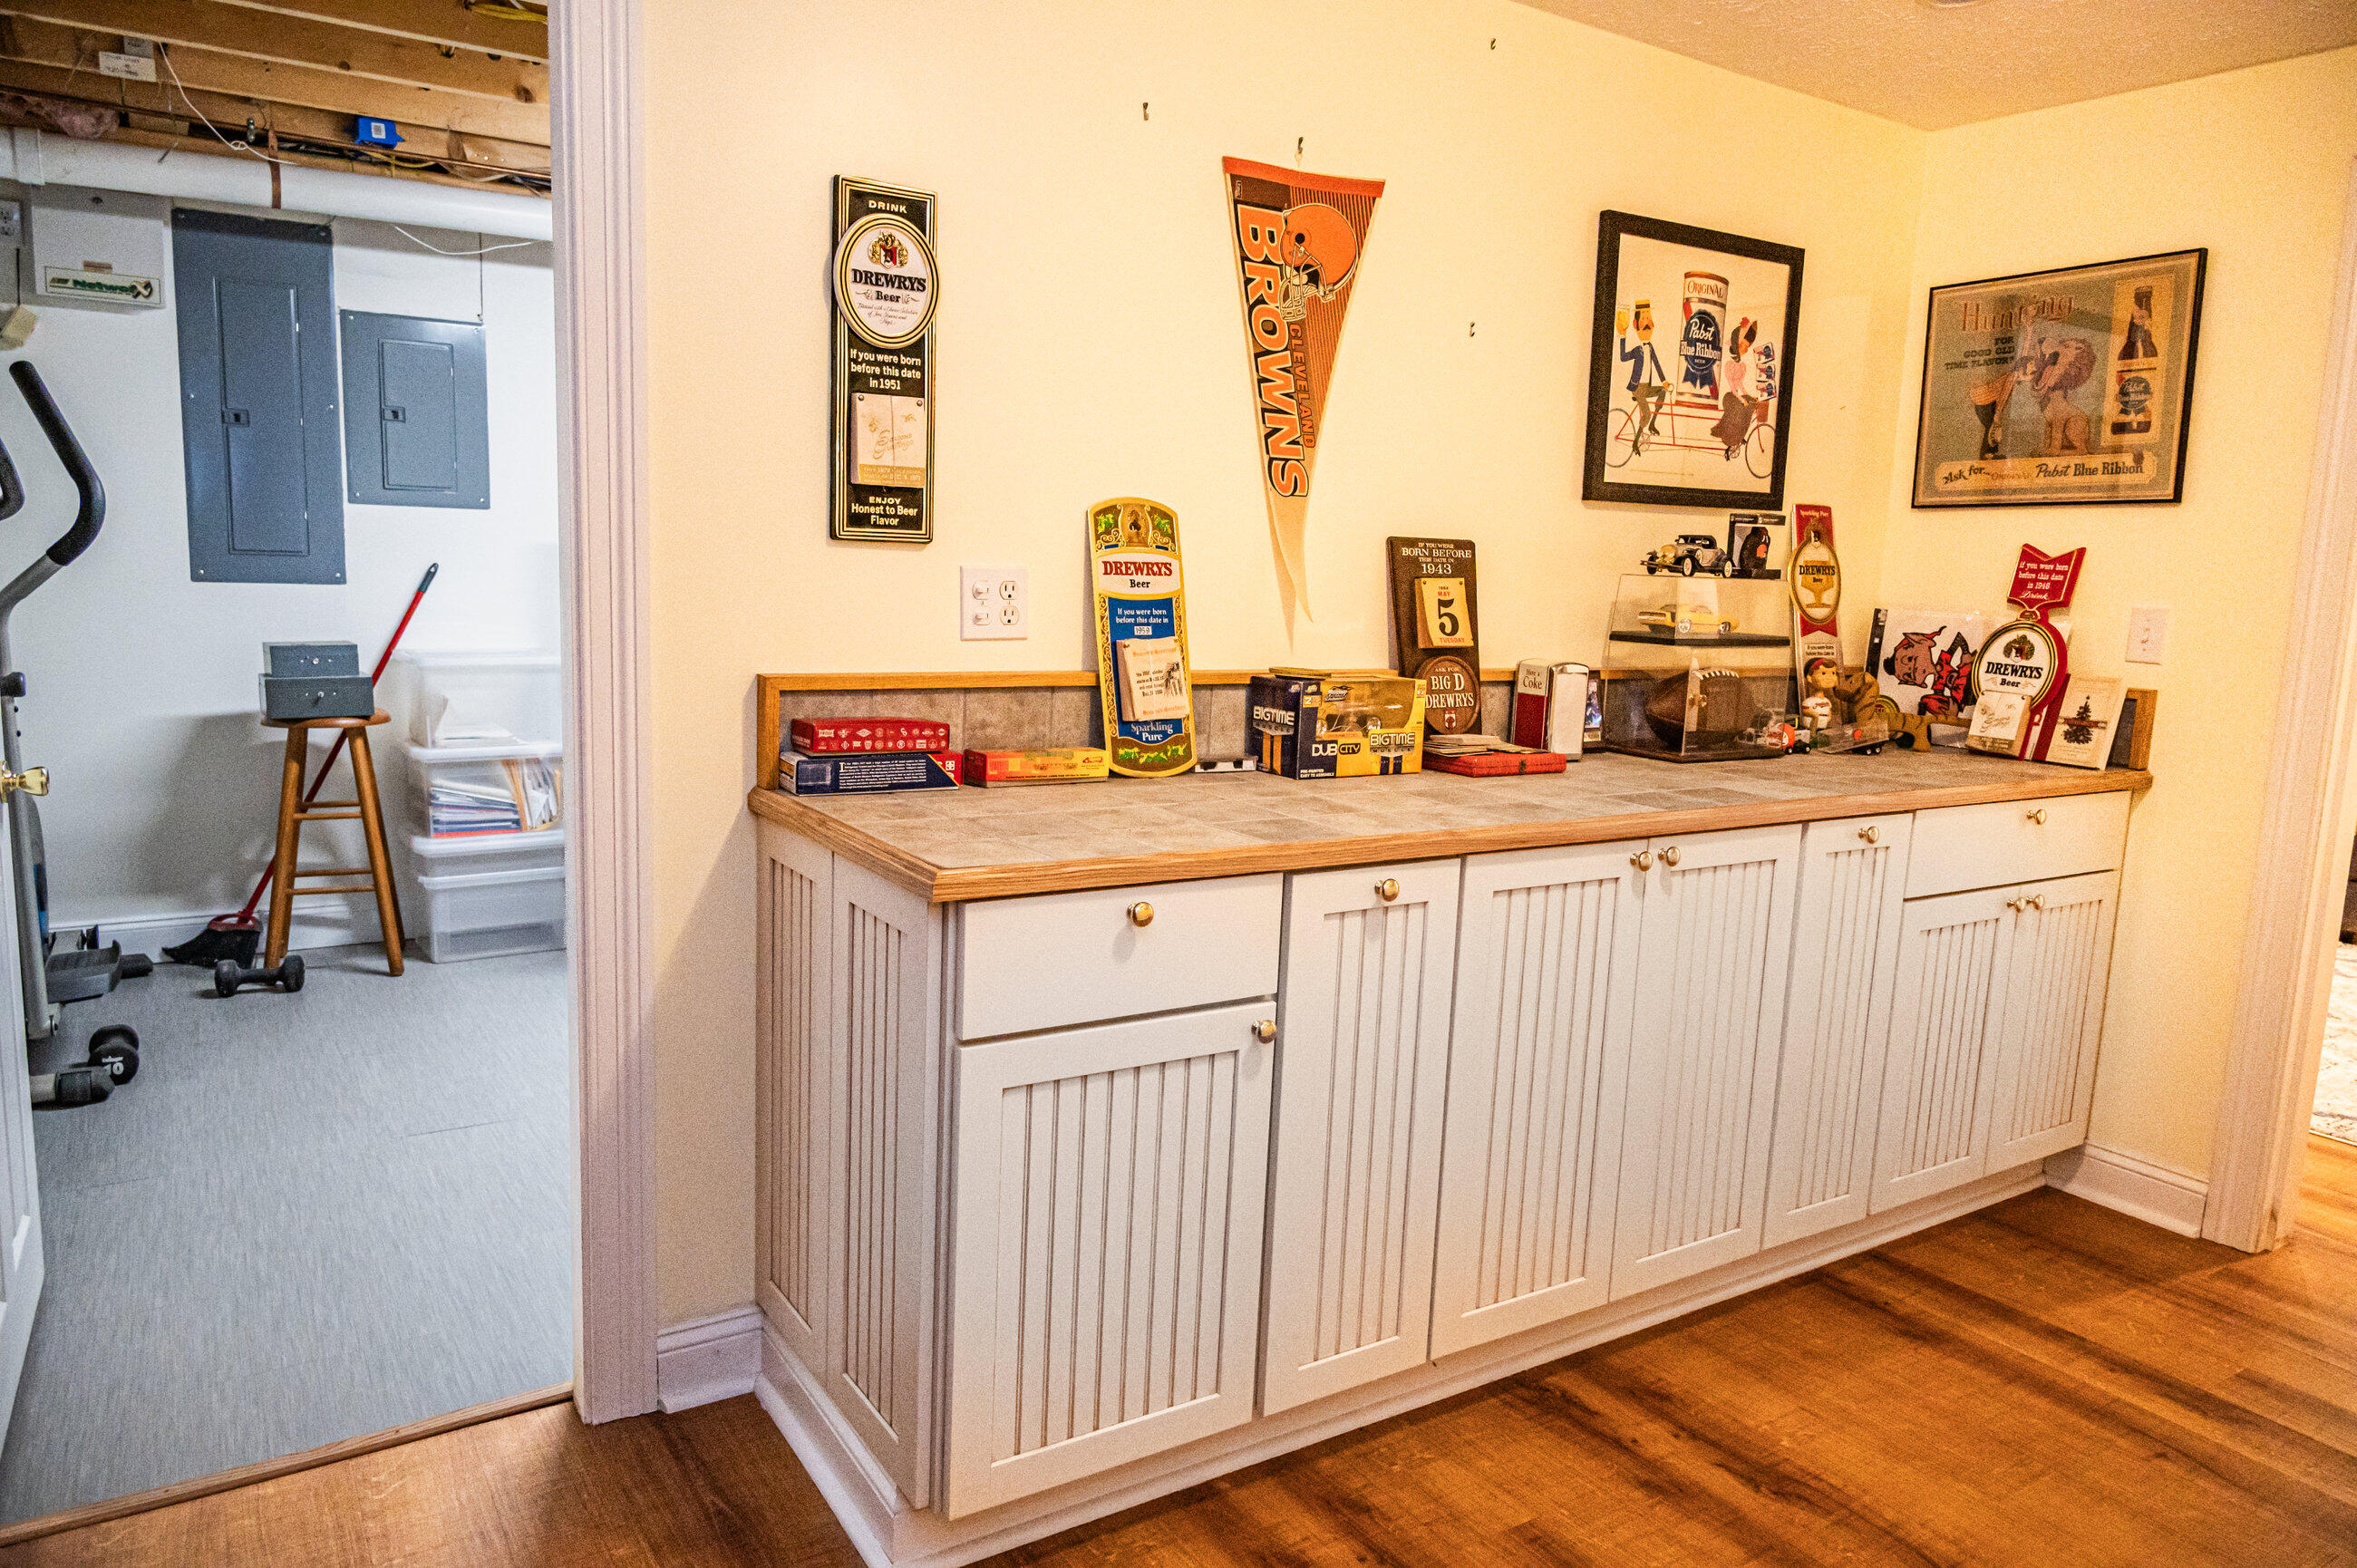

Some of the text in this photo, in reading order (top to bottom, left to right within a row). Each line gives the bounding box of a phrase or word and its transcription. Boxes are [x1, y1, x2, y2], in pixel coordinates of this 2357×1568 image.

[868, 199, 907, 214] DRINK
[851, 268, 926, 292] DREWRYS
[1687, 280, 1723, 298] ORIGINAL
[876, 290, 901, 303] Beer
[1689, 318, 1715, 342] Pabst
[1995, 336, 2014, 345] FOR
[850, 348, 921, 366] If you were born
[1236, 203, 1309, 497] BROWNS
[1680, 341, 1722, 361] Blue Ribbon
[850, 362, 921, 379] before this date
[869, 377, 901, 390] in 1951
[1289, 323, 1315, 448] CLEVELAND
[2035, 463, 2071, 479] Pabst
[2073, 463, 2099, 476] Blue
[2101, 460, 2144, 475] Ribbon
[1942, 469, 1968, 485] Ask
[869, 497, 901, 505] ENJOY
[851, 503, 917, 516] Honest to Beer
[870, 515, 899, 526] Flavor
[1401, 547, 1472, 558] BORN BEFORE
[1101, 561, 1173, 576] DREWRYS
[1421, 563, 1452, 575] 1943
[1799, 565, 1836, 576] DREWRYS
[2037, 572, 2050, 580] this
[1130, 579, 1150, 588] Beer
[1117, 607, 1123, 615] If
[1152, 607, 1167, 615] born
[1438, 598, 1459, 637] 5
[1135, 626, 1150, 634] 1959
[1984, 661, 2043, 680] DREWRYS
[1431, 673, 1465, 691] BIG D
[1523, 675, 1543, 689] Coke
[2000, 678, 2022, 688] Beer
[1305, 696, 1313, 705] 2
[1425, 692, 1475, 709] DREWRYS
[1253, 705, 1295, 726] BIGTIME
[1131, 721, 1173, 734] Sparkling
[1142, 731, 1163, 741] Pure
[1370, 732, 1415, 745] BIGTIME
[1312, 743, 1360, 757] DUB CITY
